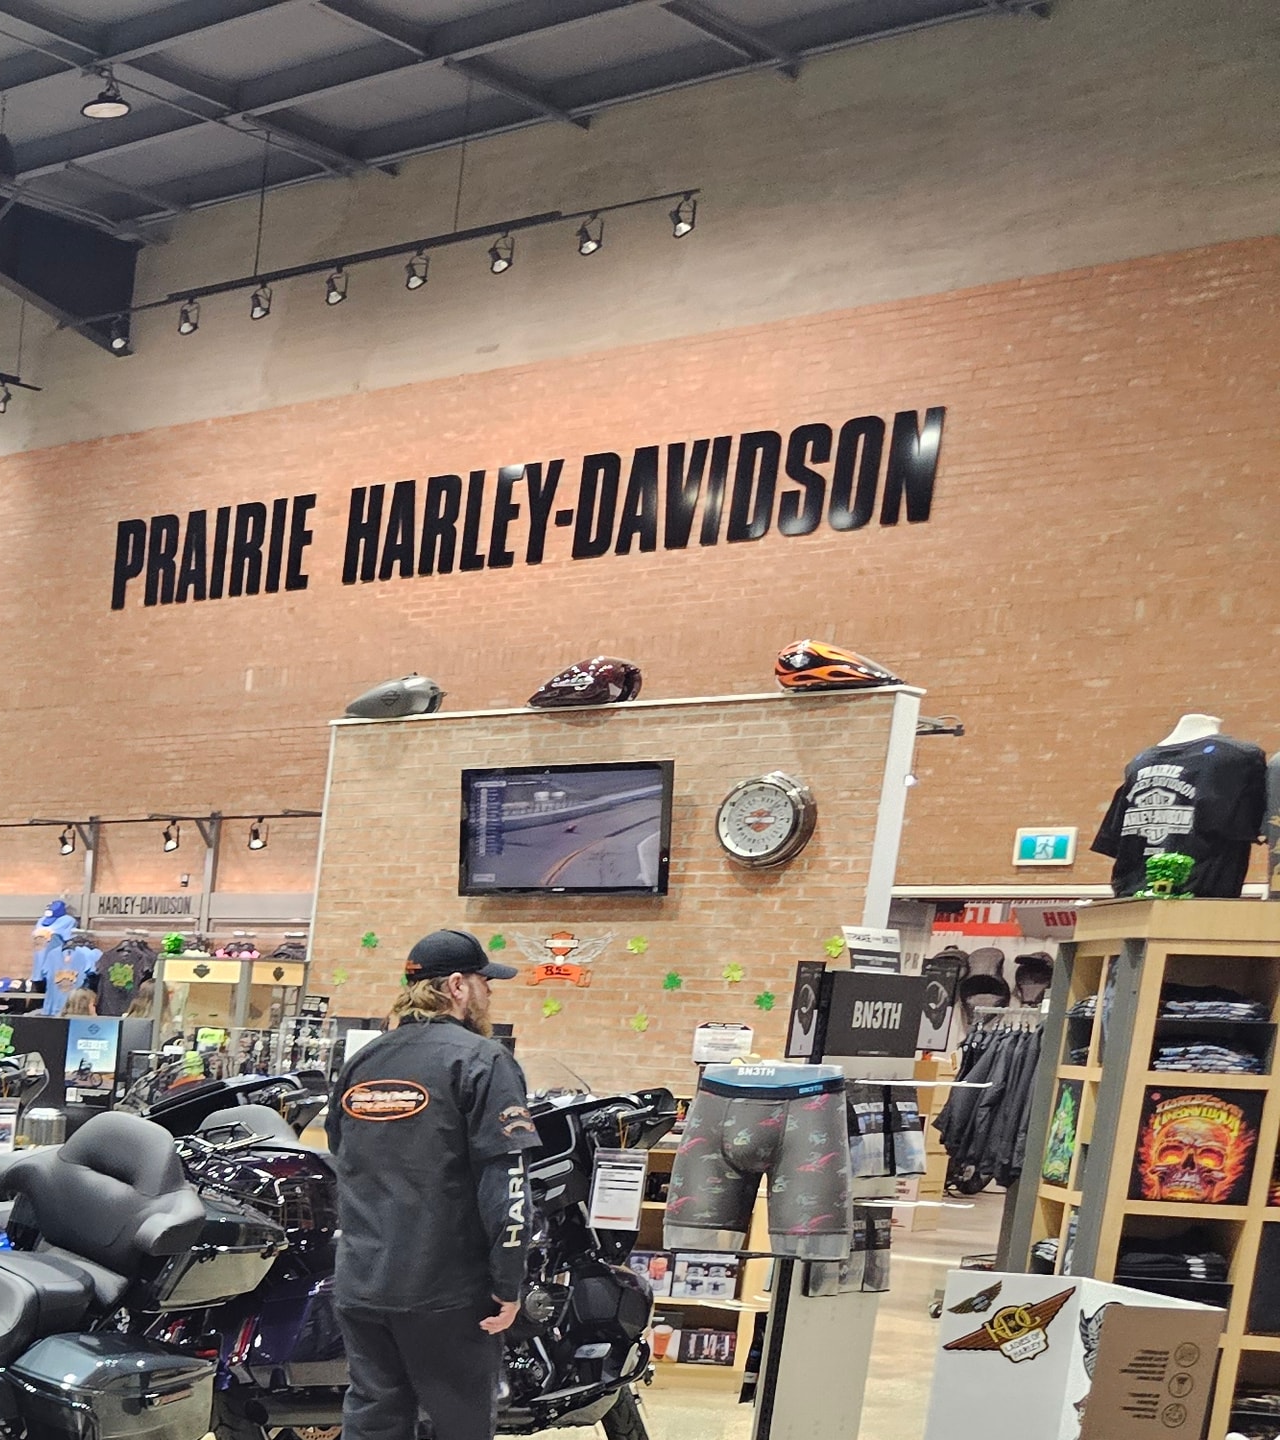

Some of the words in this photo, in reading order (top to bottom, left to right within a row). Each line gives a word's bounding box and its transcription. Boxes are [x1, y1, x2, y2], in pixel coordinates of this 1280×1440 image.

[111, 494, 316, 611] PRAIRIE
[341, 406, 946, 586] HARLEY-DAVIDSON
[98, 896, 192, 915] HARLEY-DAVIDSON
[851, 1000, 903, 1030] BN3TH
[737, 1066, 776, 1077] BN3TH
